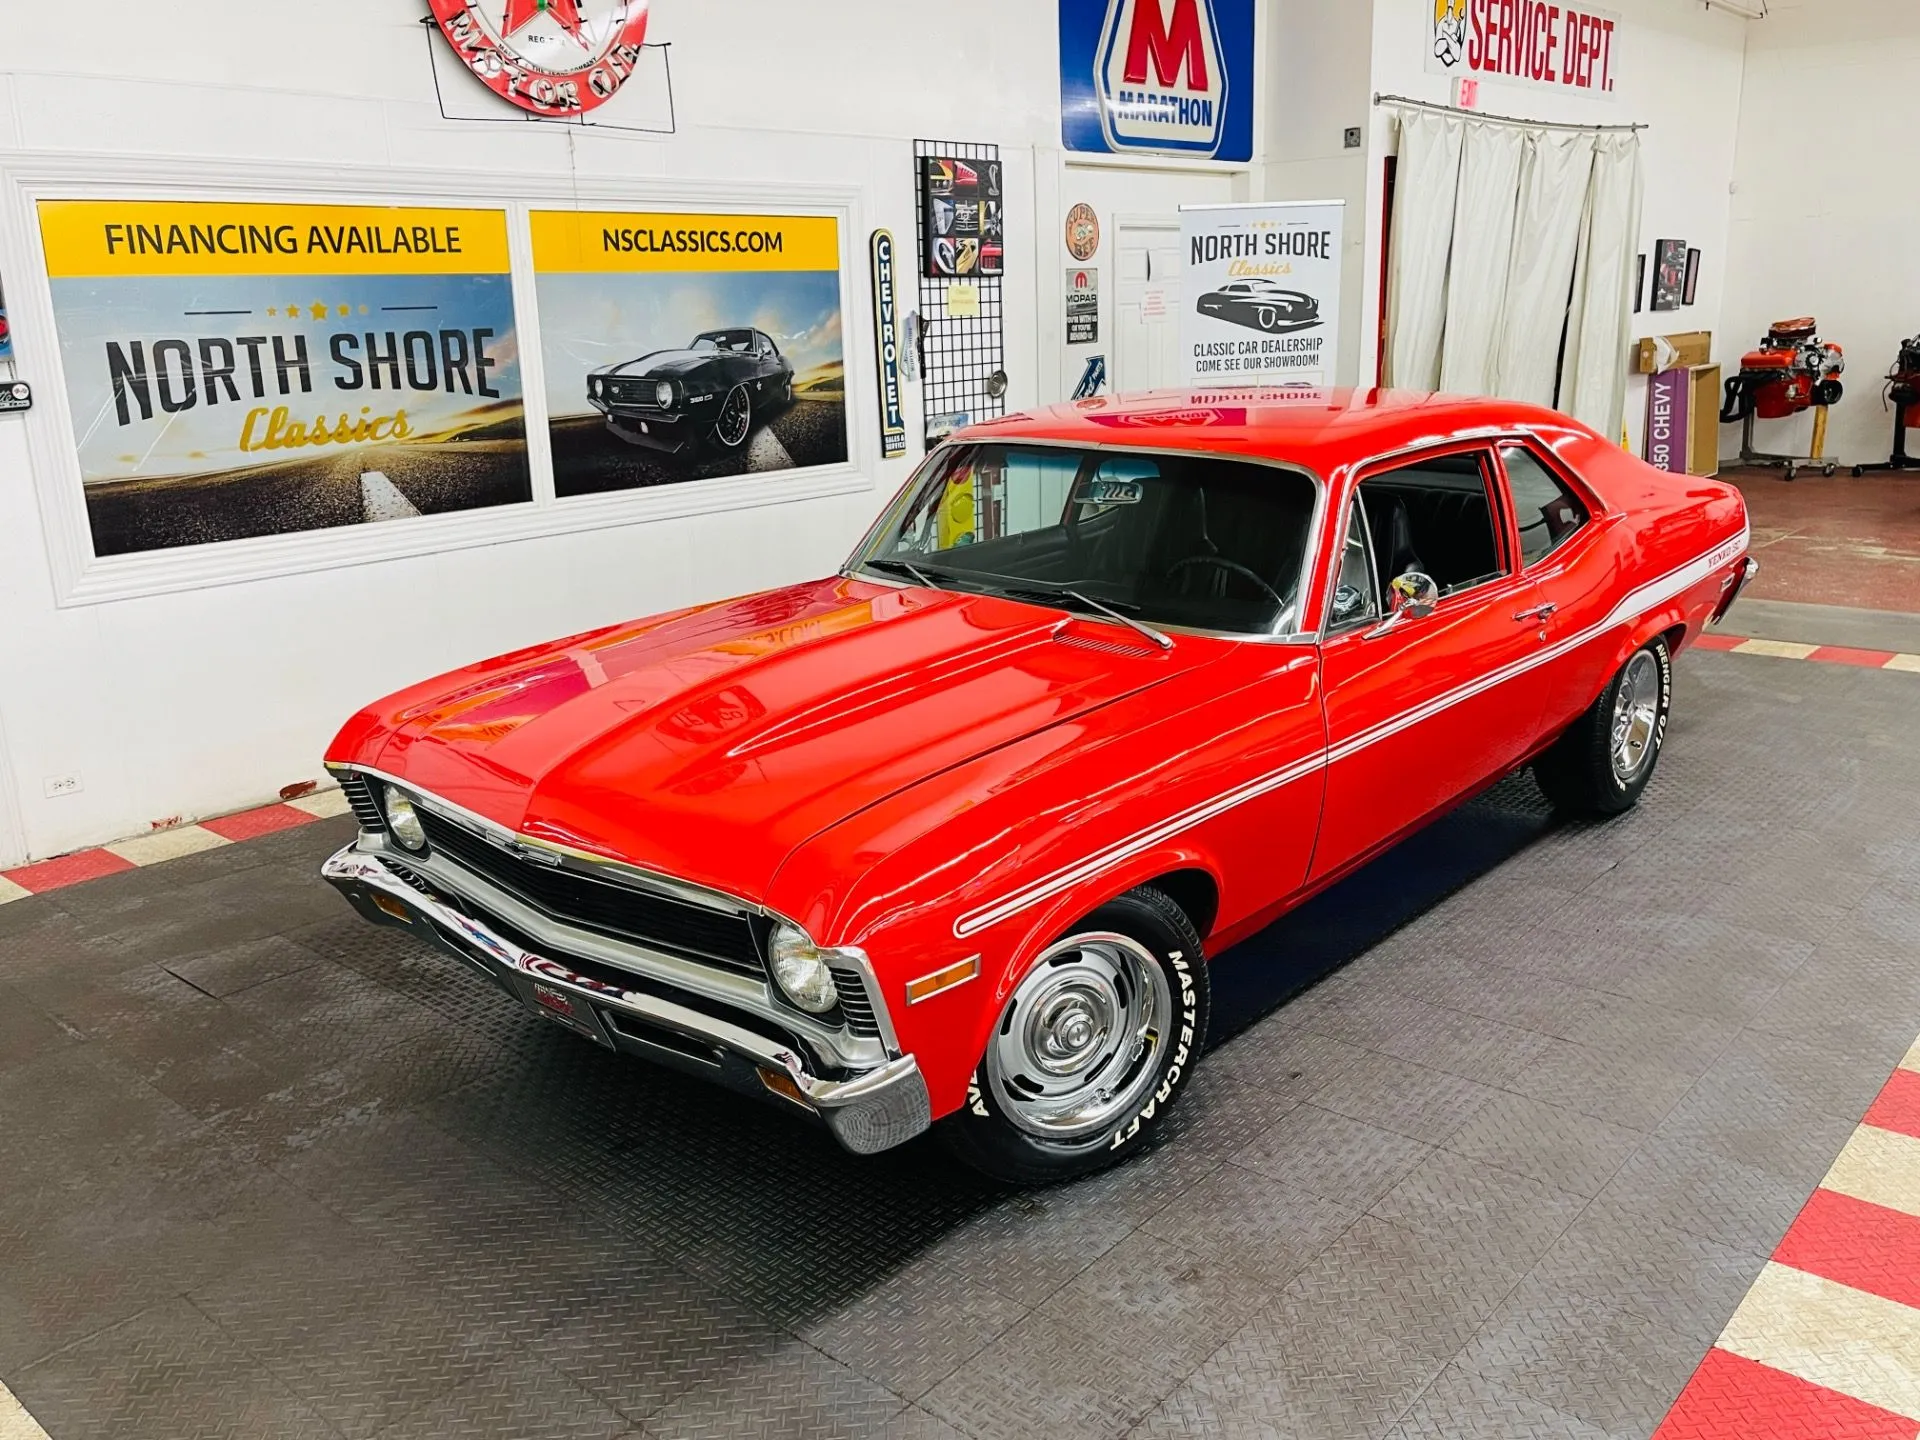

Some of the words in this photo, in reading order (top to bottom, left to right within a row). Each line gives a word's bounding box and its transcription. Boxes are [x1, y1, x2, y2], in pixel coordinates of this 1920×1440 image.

[1123, 0, 1208, 92] M
[1467, 0, 1559, 82] SERVICE
[1562, 10, 1614, 92] DEPT.
[1118, 90, 1212, 127] MARATHON
[105, 223, 298, 255] FINANCING
[306, 226, 462, 254] AVAILABLE
[602, 228, 783, 253] NSCLASSICS.COM
[1191, 233, 1257, 265] NORTH
[1265, 231, 1331, 260] SHORE
[1228, 260, 1292, 277] Classics
[1066, 294, 1097, 303] MOPAR
[879, 241, 898, 424] CHEVROLET
[1194, 342, 1235, 357] CLASSIC
[1238, 341, 1258, 355] CAR
[1261, 337, 1323, 353] DEALERSHIP
[106, 332, 314, 428] NORTH
[329, 327, 500, 399] SHORE
[1196, 359, 1221, 372] COME
[1224, 358, 1240, 371] SEE
[1243, 357, 1262, 370] OUR
[1263, 354, 1319, 369] SHOWROOM!
[239, 406, 414, 453] Classics
[1654, 383, 1671, 439] CHEVY
[1110, 950, 1196, 1150] MASTERCRAFT
